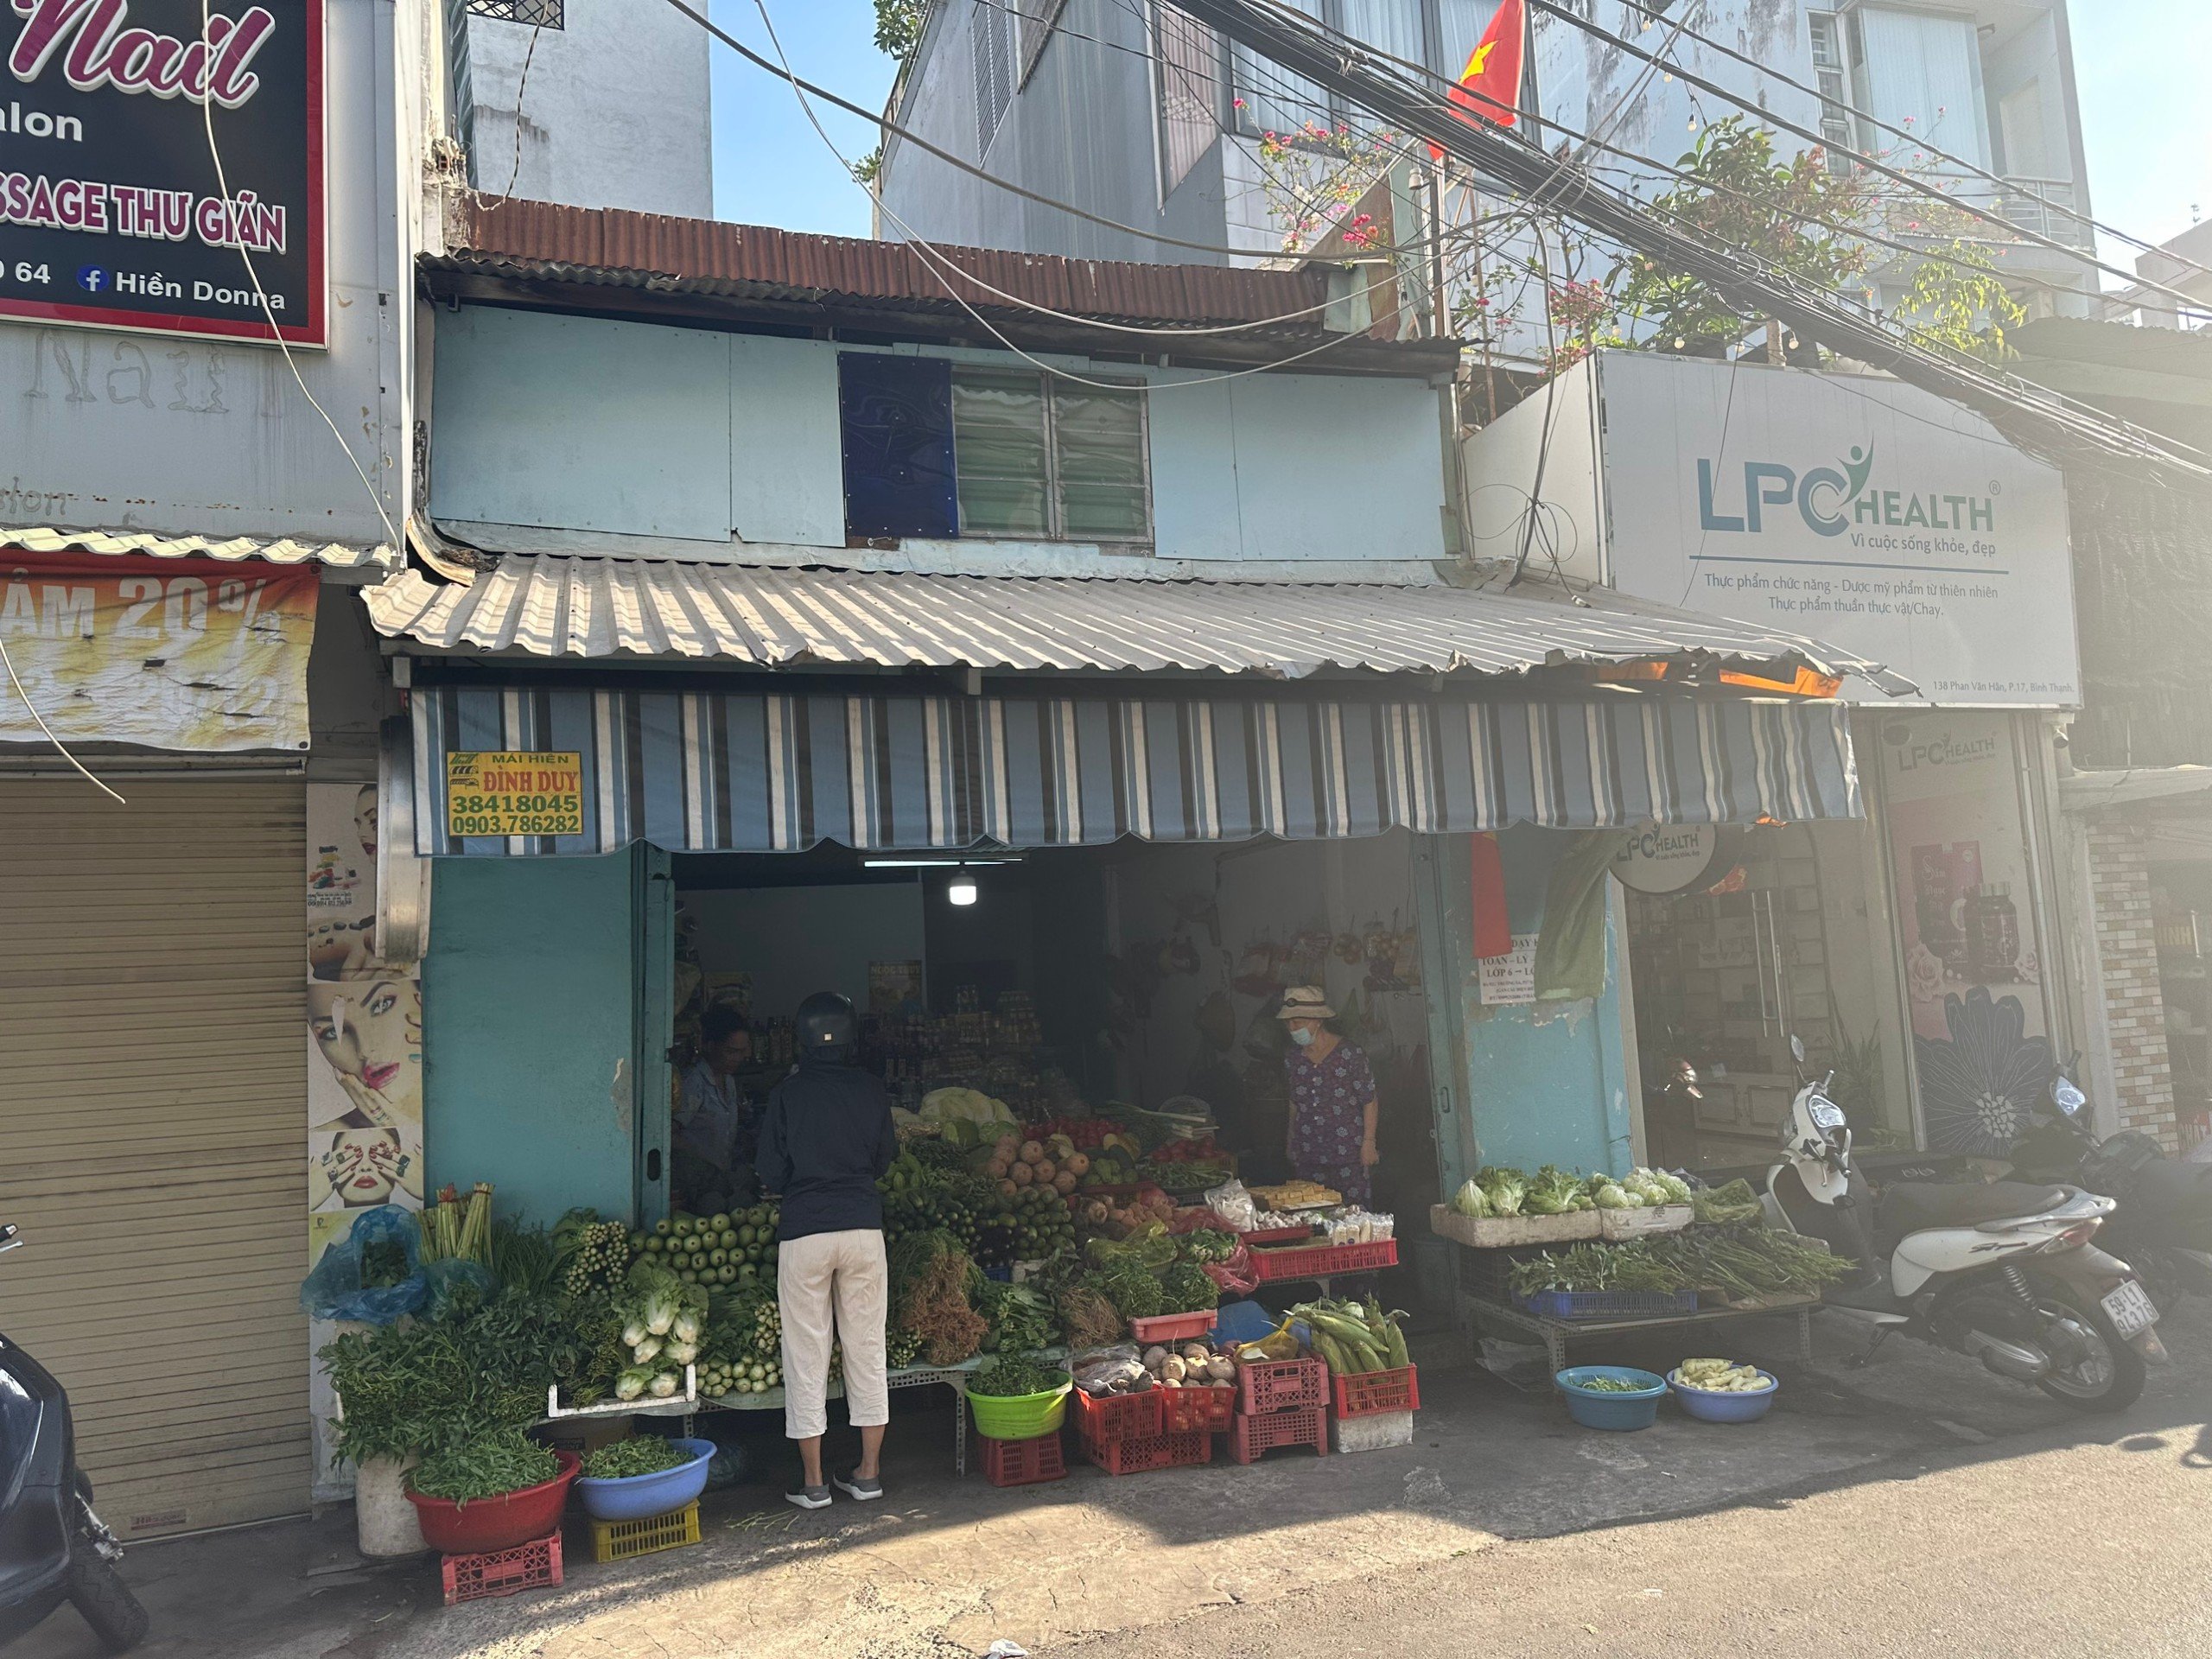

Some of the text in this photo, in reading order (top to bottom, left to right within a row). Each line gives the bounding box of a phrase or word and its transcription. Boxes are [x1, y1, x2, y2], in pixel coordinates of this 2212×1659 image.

[111, 184, 193, 241] THƯ
[195, 189, 286, 254] GIÃN
[15, 262, 51, 283] 64
[116, 271, 182, 298] Hiền
[194, 281, 286, 309] Donna
[1851, 533, 1997, 557] Vì cuộc sống khỏe, đẹp
[1704, 573, 1734, 588] Thực
[1737, 573, 1770, 591] phẩm
[1773, 575, 1800, 590] chức
[1803, 577, 1831, 594] năng
[1842, 579, 1872, 594] Dược
[1873, 582, 1891, 597] mỹ
[1893, 580, 1924, 598] phẩm
[1926, 582, 1937, 596] từ
[1940, 582, 1967, 597] thiên
[1968, 583, 1999, 599] nhiên
[1768, 596, 1796, 612] Thực
[1799, 596, 1831, 613] phẩm
[1834, 597, 1866, 613] thuần
[1867, 600, 1892, 615] thực
[1933, 681, 1948, 690] 138
[1950, 681, 1969, 691] Phan
[1971, 681, 1986, 691] Văn
[492, 753, 569, 764] MÁI HIÊN
[537, 771, 579, 792] DUY
[452, 795, 578, 814] 38418045
[452, 815, 579, 834] 0903.786282
